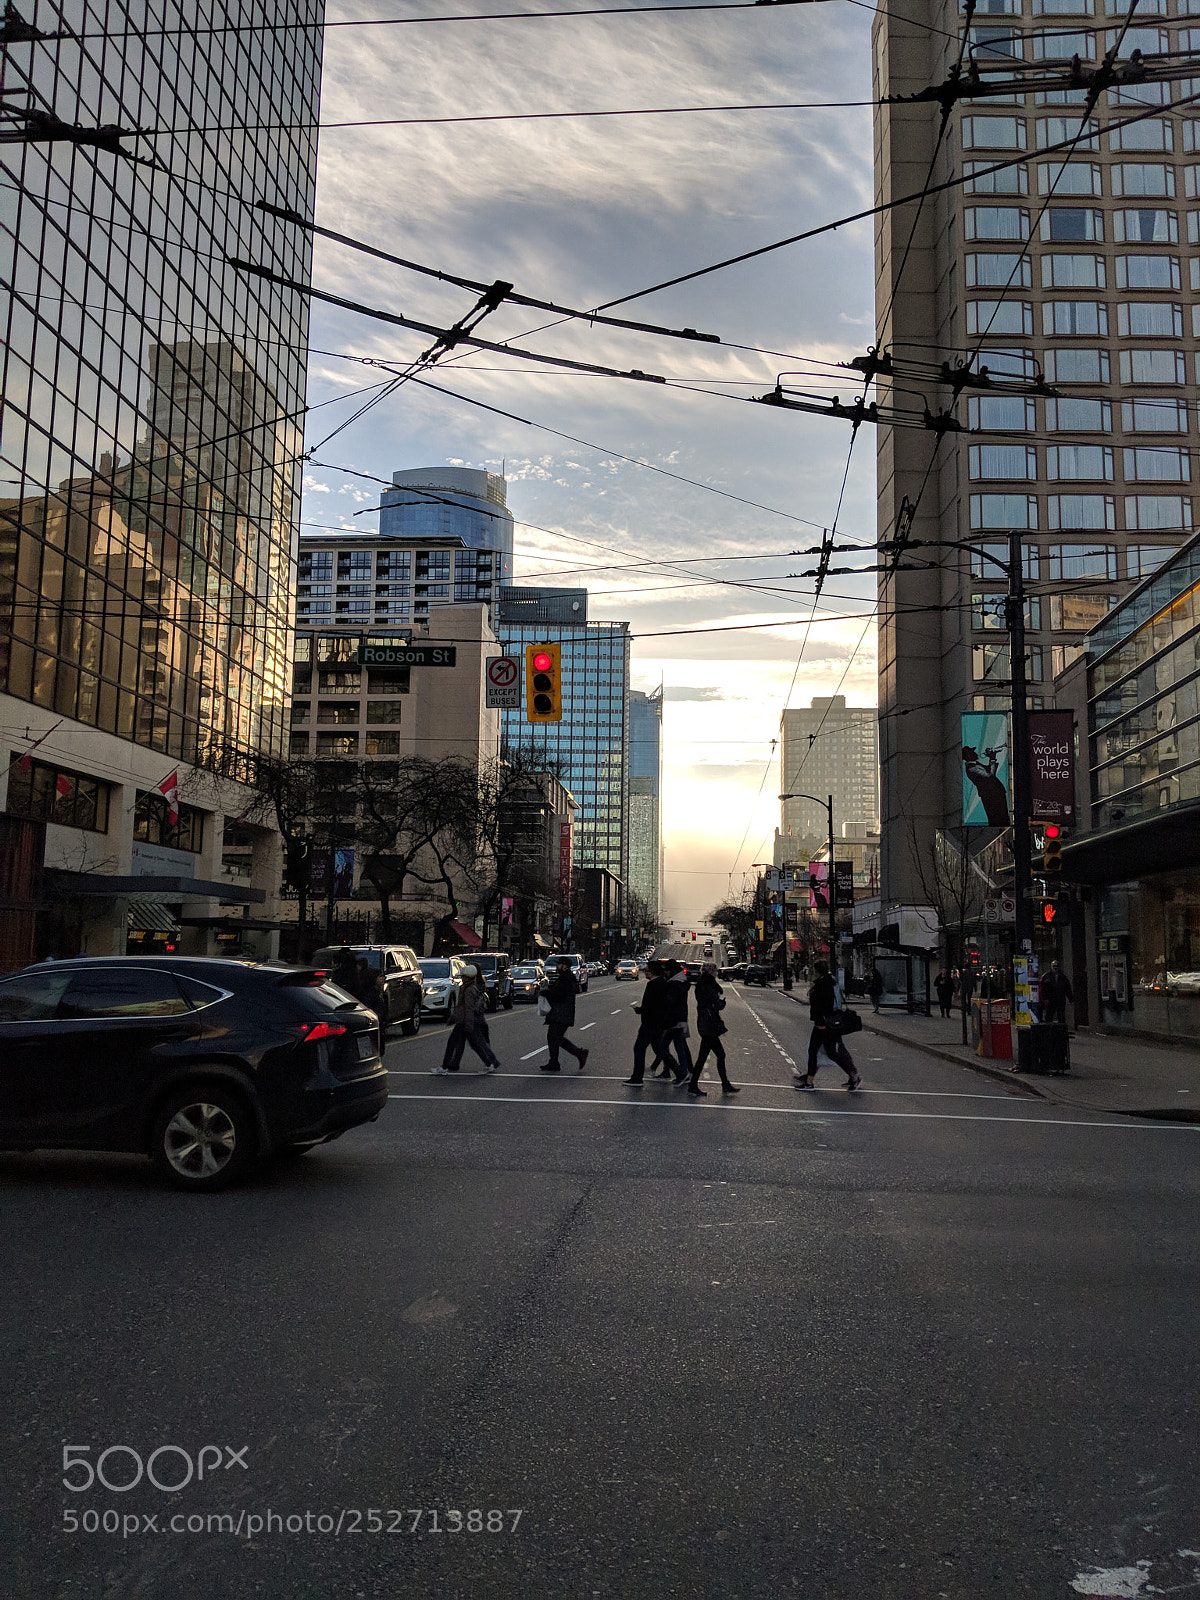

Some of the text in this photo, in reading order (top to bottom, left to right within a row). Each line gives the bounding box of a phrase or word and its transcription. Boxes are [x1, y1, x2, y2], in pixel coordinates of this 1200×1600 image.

[364, 648, 450, 663] Robson St
[489, 688, 517, 696] EXCEPT
[490, 697, 516, 705] BUSES
[1030, 734, 1047, 745] The
[1032, 742, 1069, 755] world
[1036, 755, 1070, 770] plays
[1041, 767, 1070, 779] here
